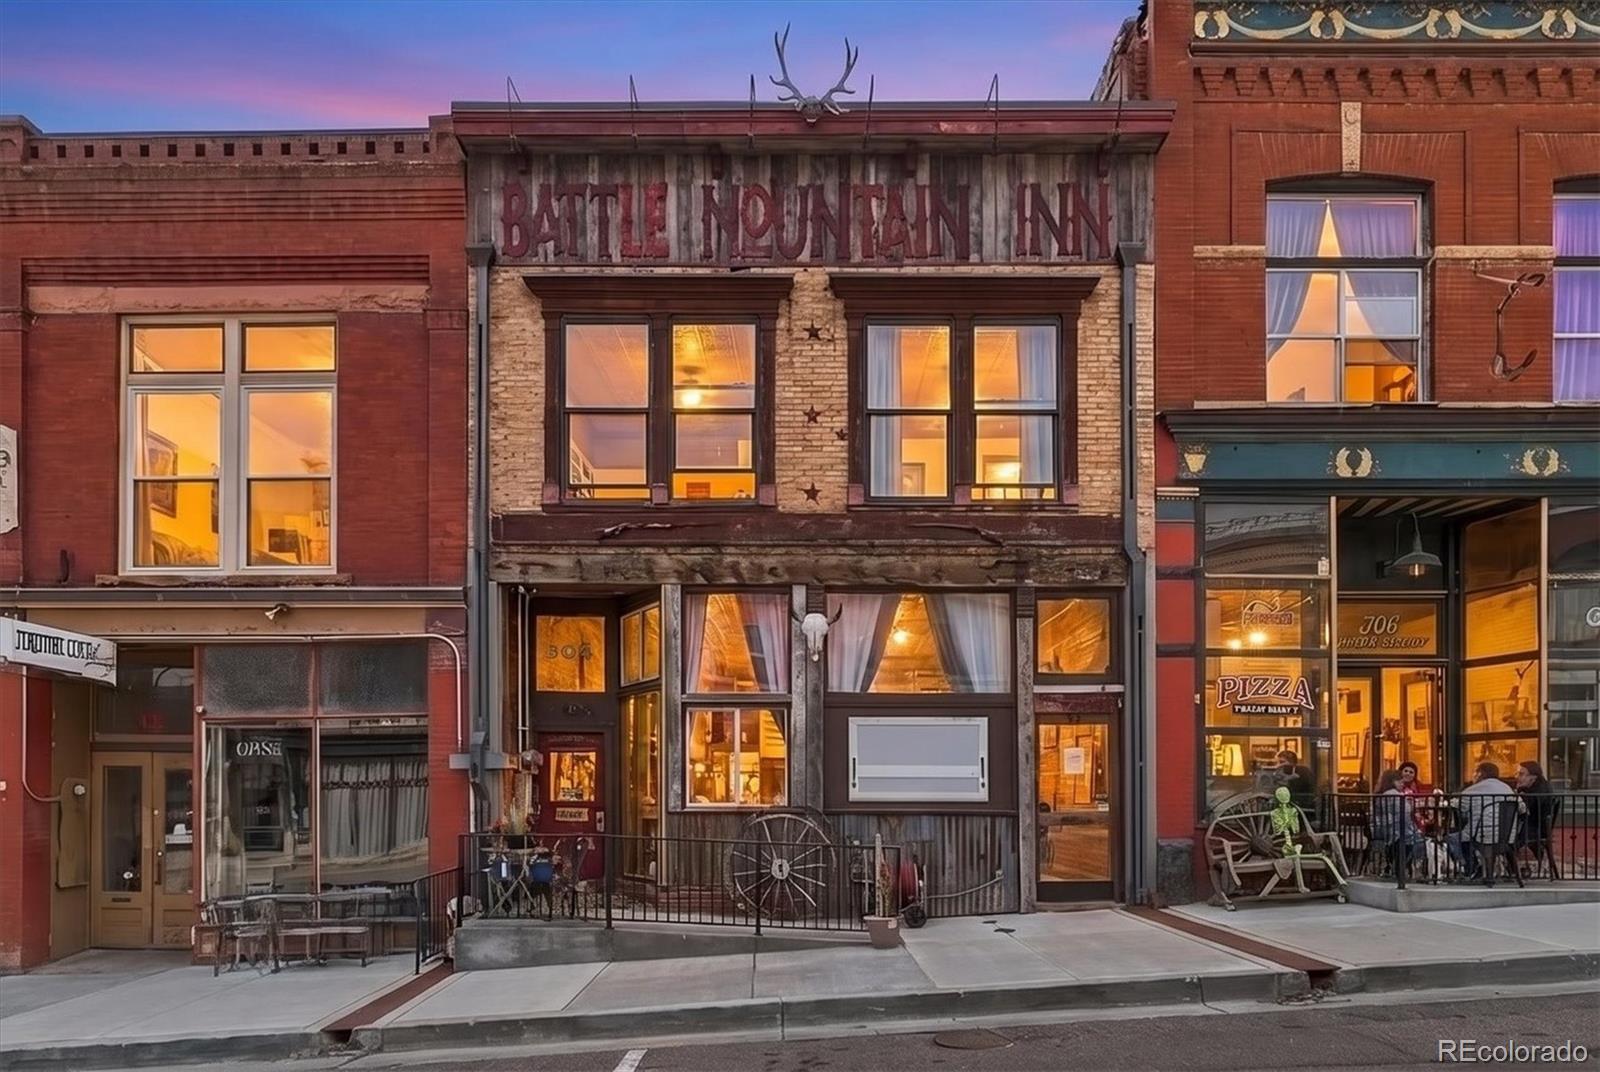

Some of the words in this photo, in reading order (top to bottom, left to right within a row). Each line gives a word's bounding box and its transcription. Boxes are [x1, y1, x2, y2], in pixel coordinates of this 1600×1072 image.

[500, 183, 670, 258] BATTLE
[1015, 183, 1112, 258] INN
[1216, 675, 1315, 710] PIZZA
